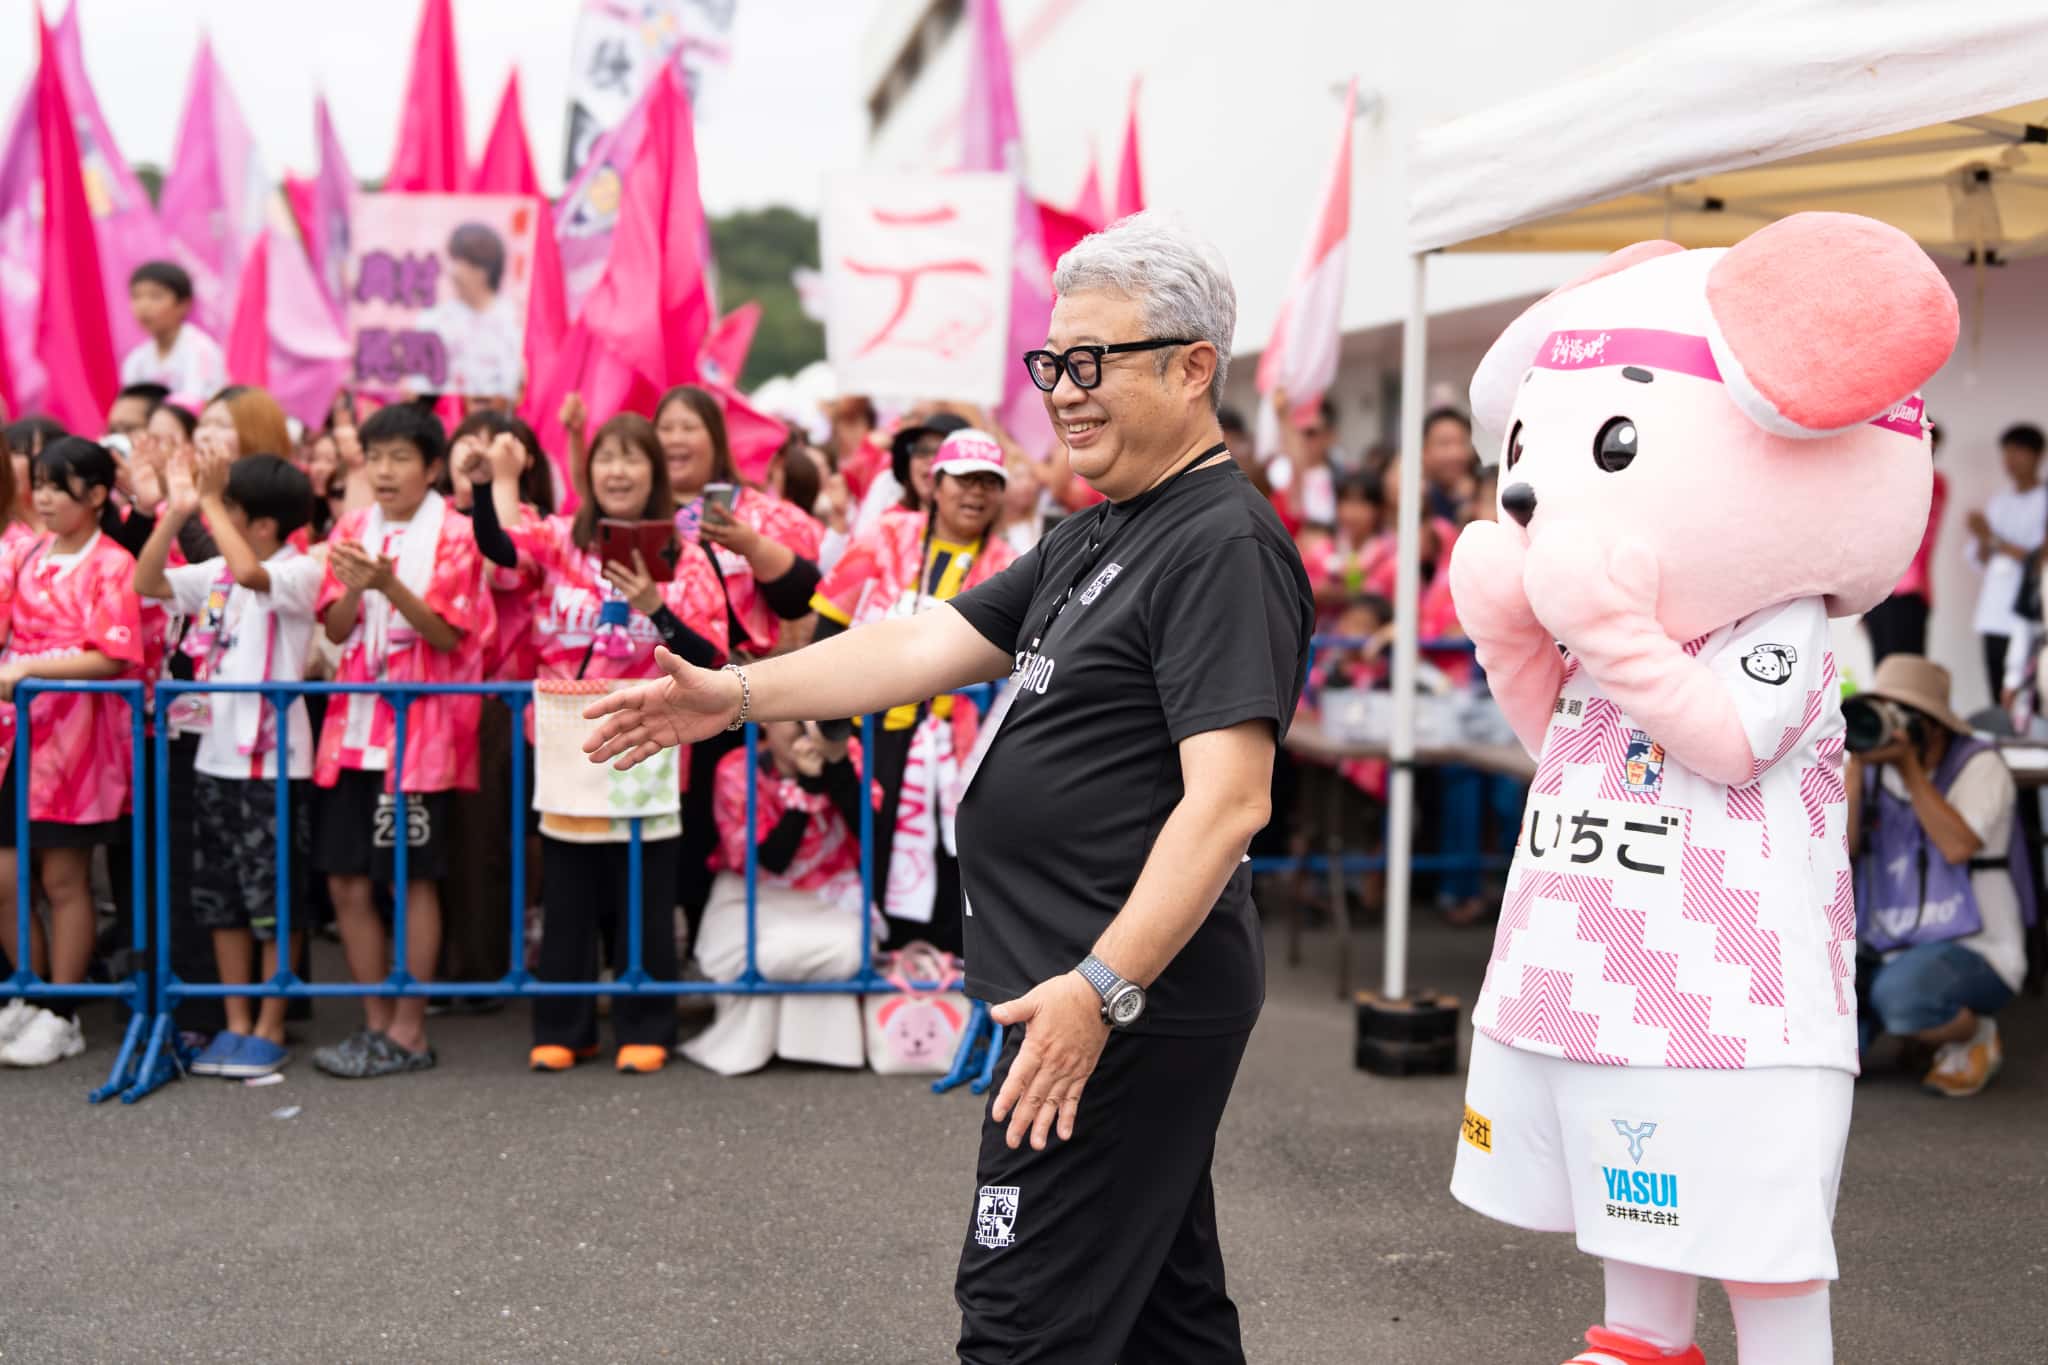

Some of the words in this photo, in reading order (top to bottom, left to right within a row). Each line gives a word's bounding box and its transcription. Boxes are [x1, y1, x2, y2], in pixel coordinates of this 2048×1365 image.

[1530, 809, 1679, 875] いちご
[1602, 1166, 1678, 1208] YASUI
[1606, 1203, 1680, 1227] 安井株式会社
